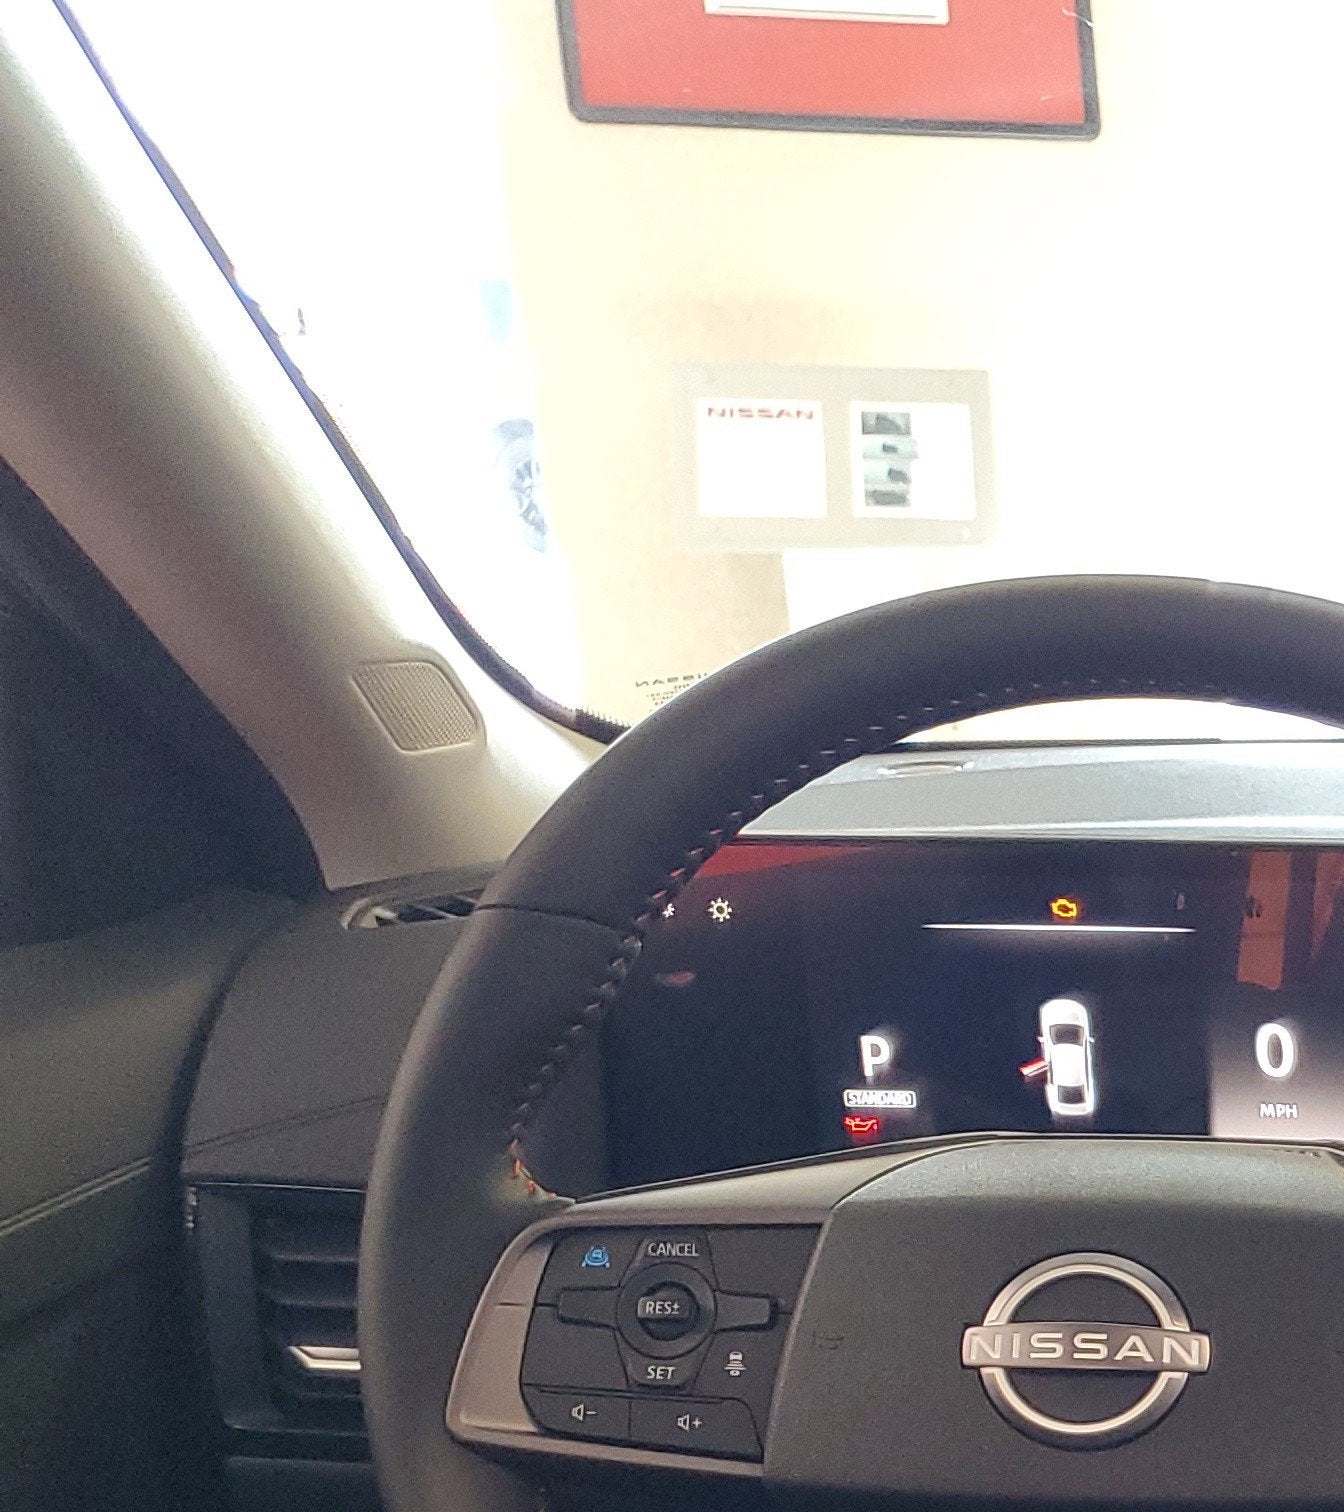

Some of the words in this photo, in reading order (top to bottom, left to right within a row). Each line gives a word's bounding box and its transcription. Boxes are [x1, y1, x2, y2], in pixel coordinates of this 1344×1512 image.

[708, 407, 814, 420] NISSAN
[860, 1035, 890, 1077] P
[1255, 1022, 1296, 1078] 0
[846, 1091, 914, 1106] STANDARD
[1261, 1103, 1298, 1120] MPH
[648, 1243, 699, 1257] CANCEL
[969, 1332, 1200, 1366] NISSAN
[646, 1365, 675, 1380] SET
